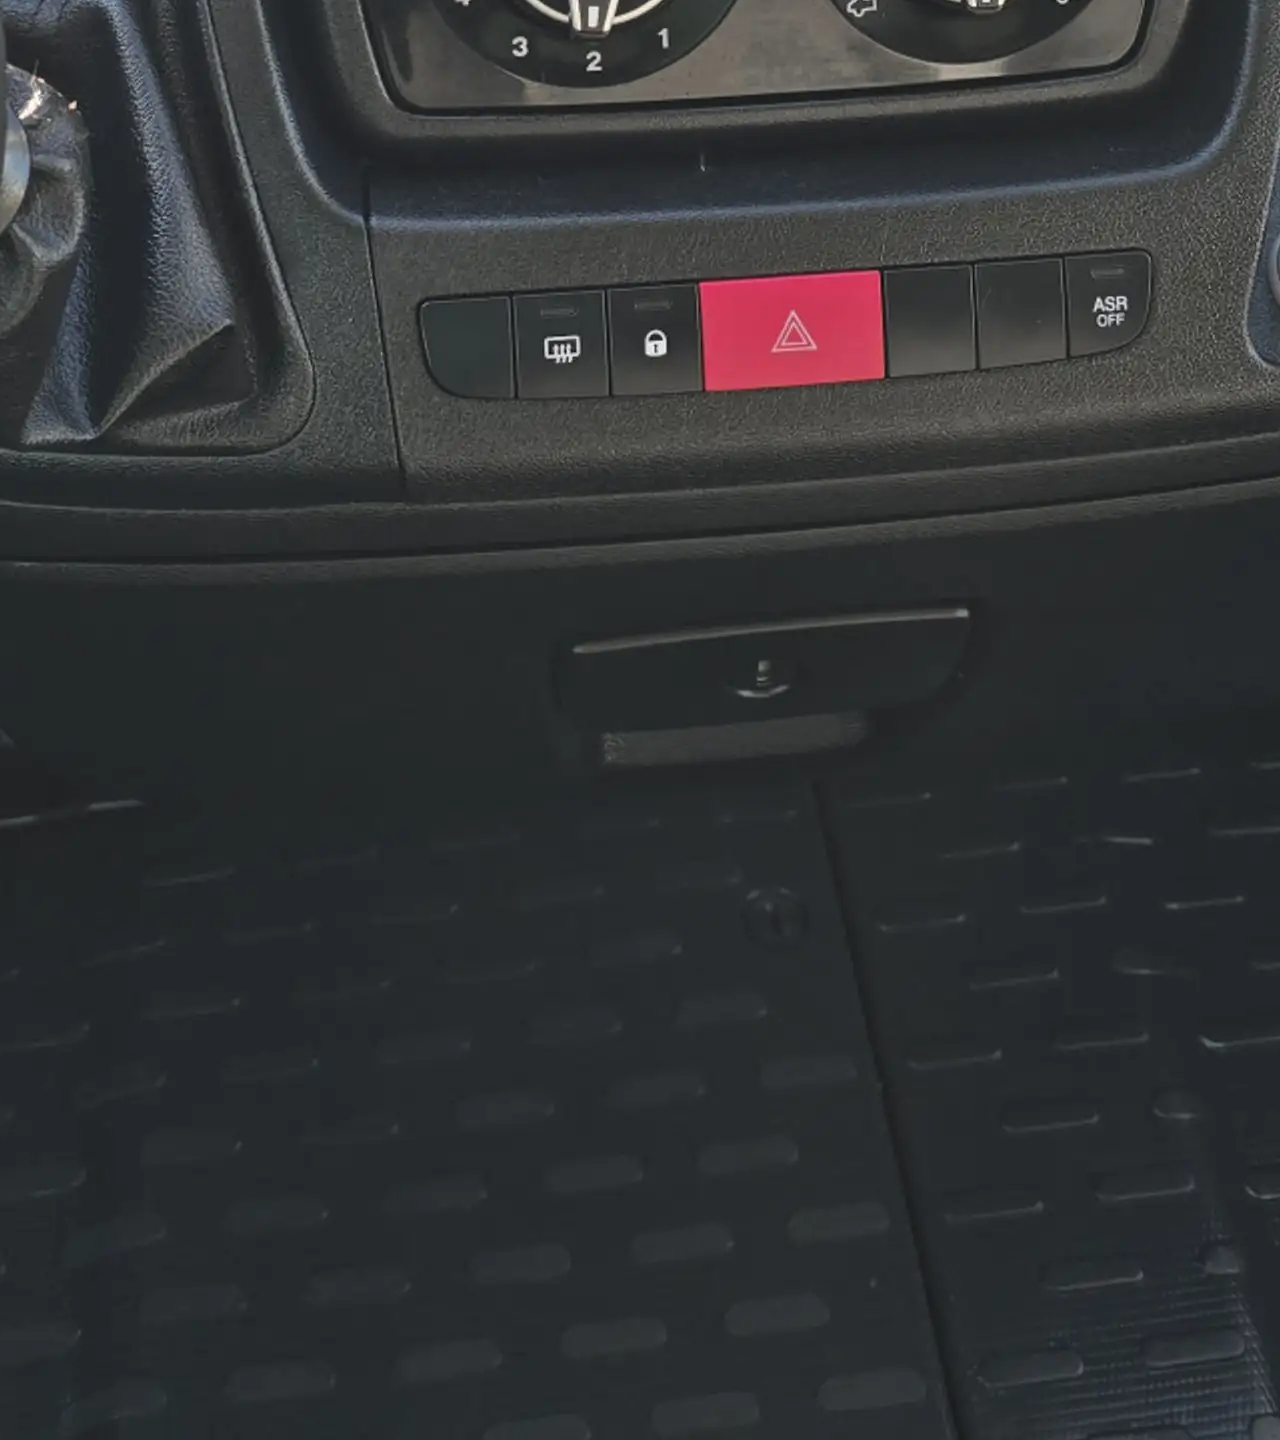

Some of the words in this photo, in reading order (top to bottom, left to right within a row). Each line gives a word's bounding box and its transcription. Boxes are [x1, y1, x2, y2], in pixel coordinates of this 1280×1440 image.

[511, 36, 529, 58] 3
[657, 28, 671, 49] 1
[586, 51, 603, 72] 2
[1093, 295, 1128, 314] ASR
[1096, 312, 1126, 328] OFF
